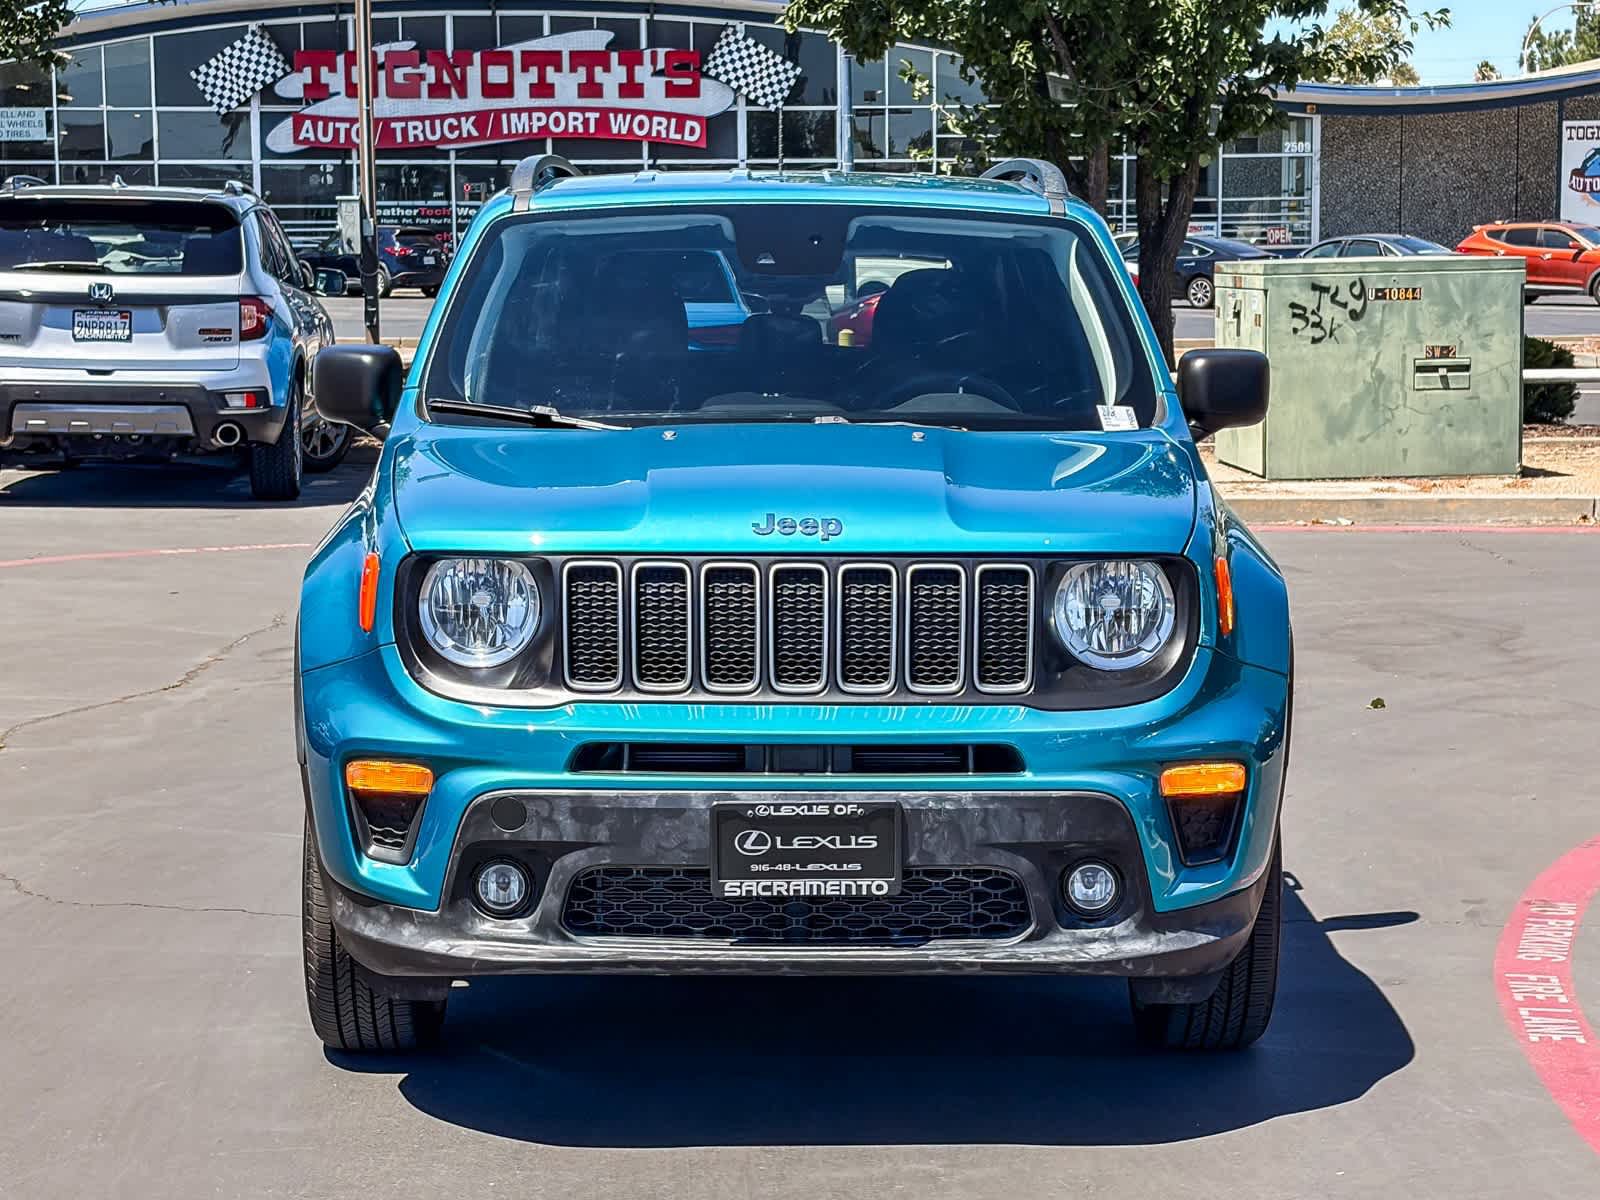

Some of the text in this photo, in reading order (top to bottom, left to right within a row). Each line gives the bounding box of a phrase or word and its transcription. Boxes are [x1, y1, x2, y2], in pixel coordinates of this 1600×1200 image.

[294, 50, 702, 99] TOGNOTTI'S
[390, 115, 480, 143] TRUCK
[501, 111, 600, 135] IMPORT
[609, 112, 702, 143] WORLD
[1566, 126, 1600, 141] TOG
[1268, 229, 1292, 244] OPEN
[1368, 287, 1422, 300] U-10844
[1425, 346, 1456, 358] SW-2
[751, 512, 843, 541] Jeep
[770, 804, 858, 816] LEXUS OF
[775, 835, 878, 849] LEXUS
[723, 880, 889, 897] SACRAMENTO
[1504, 973, 1587, 1043] FIRE LANE
